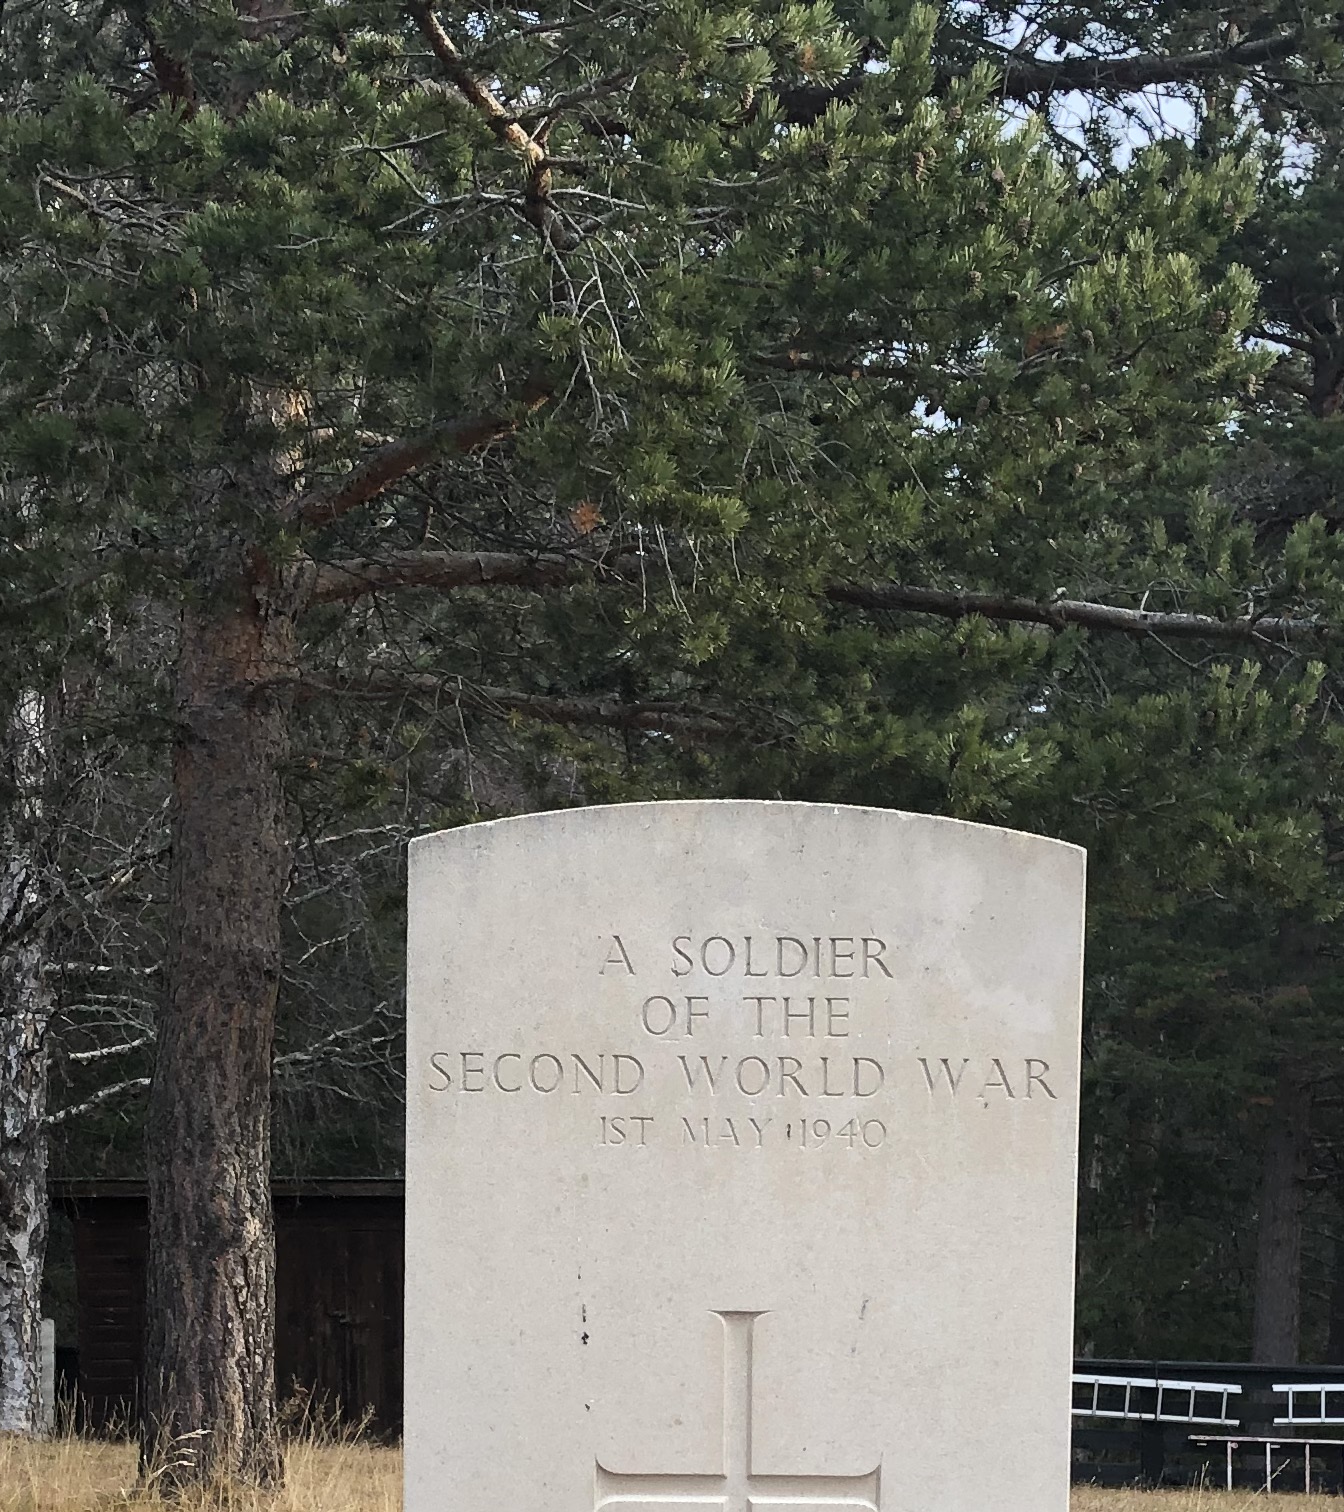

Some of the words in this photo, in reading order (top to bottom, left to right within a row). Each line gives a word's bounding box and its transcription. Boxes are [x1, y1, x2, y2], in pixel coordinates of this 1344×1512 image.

[599, 934, 637, 977] A
[671, 935, 894, 979] SOLDIER
[642, 995, 710, 1037] OF
[743, 995, 851, 1038] THE
[429, 1051, 644, 1096] SECOND
[677, 1054, 886, 1098] WORLD
[917, 1056, 1058, 1100] WAR
[682, 1116, 775, 1149] MAY
[799, 1117, 887, 1149] 1940
